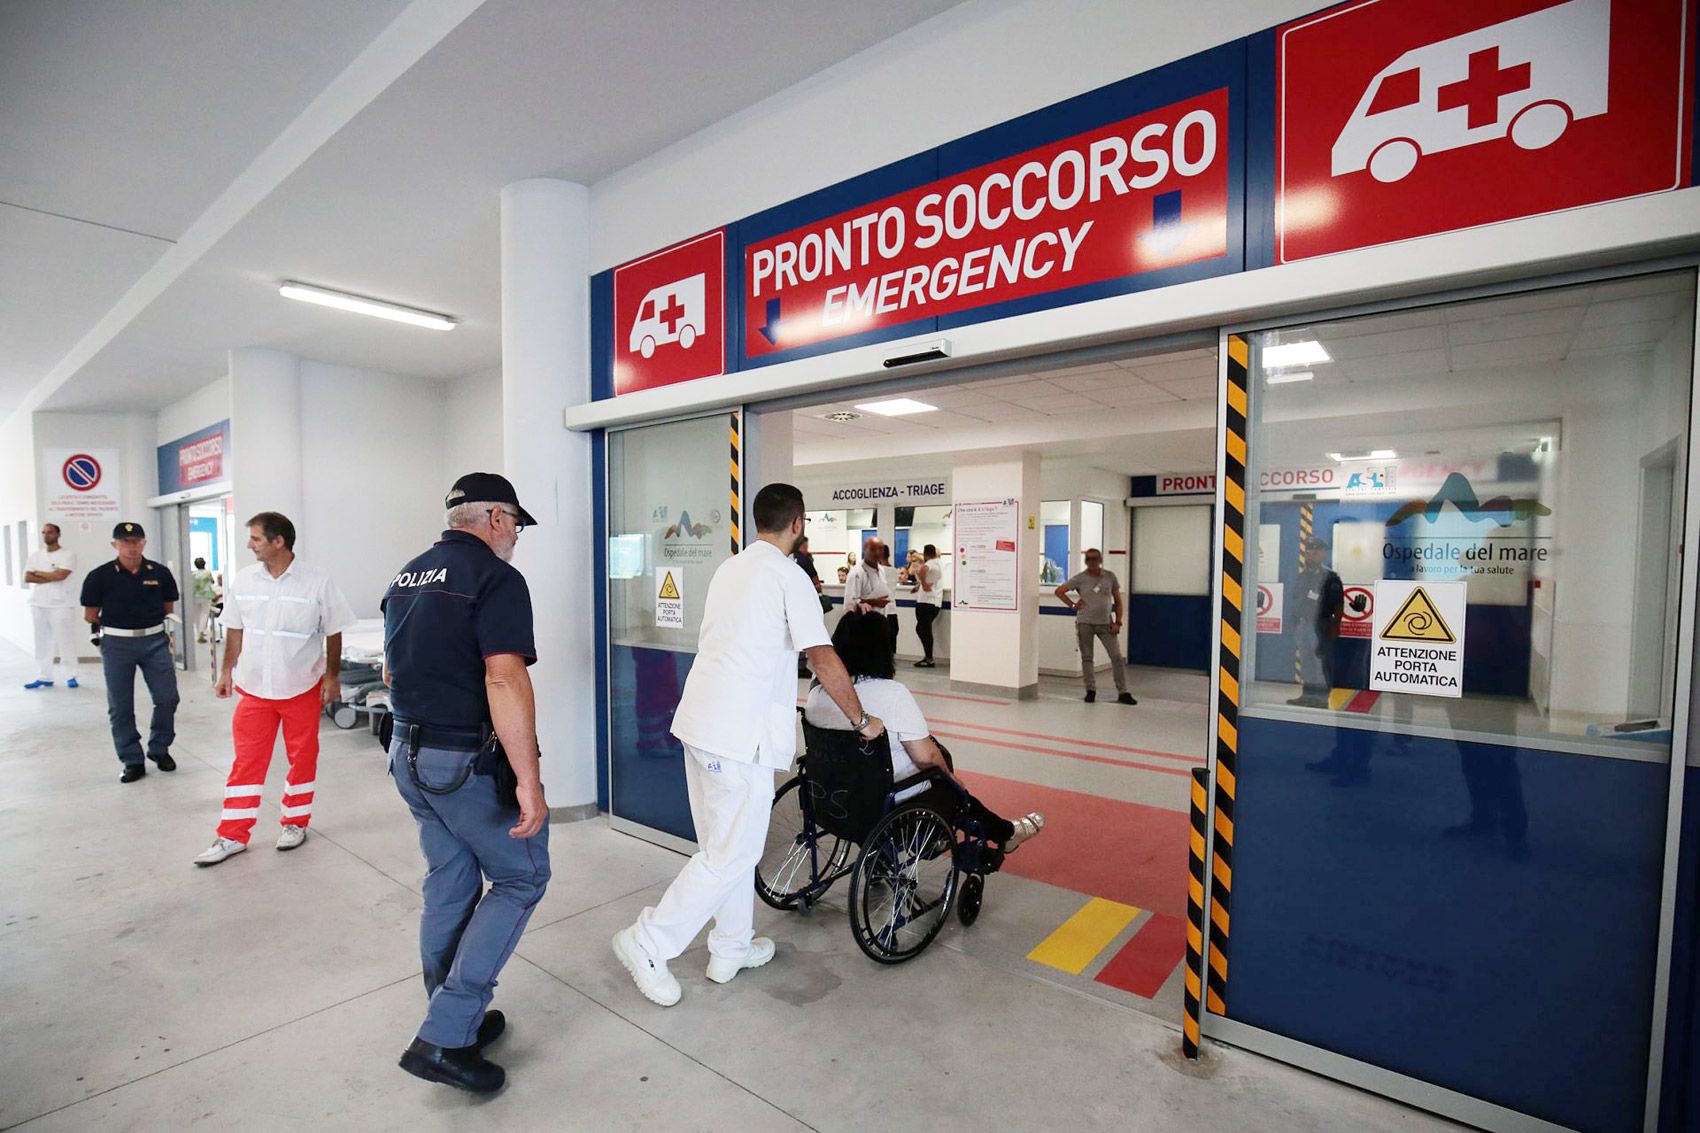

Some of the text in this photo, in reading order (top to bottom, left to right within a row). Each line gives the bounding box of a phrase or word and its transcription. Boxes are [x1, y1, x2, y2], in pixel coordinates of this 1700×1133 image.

[751, 109, 1218, 297] PRONTO SOCCORSO
[821, 220, 1095, 327] EMERGENCY
[1162, 469, 1334, 491] PRONT CCORSO
[832, 486, 898, 501] ACCOGLIENZA
[907, 483, 945, 497] TRIAGE
[1383, 543, 1548, 563] Ospedale del mare
[391, 568, 447, 587] POLIZIA
[1416, 564, 1442, 573] lavoro
[1444, 565, 1458, 575] per
[1470, 565, 1485, 574] tua
[1486, 565, 1514, 574] salute
[1377, 646, 1457, 661] ATTENZIONE
[1394, 660, 1438, 673] PORTA
[1374, 671, 1458, 687] AUTOMATICA
